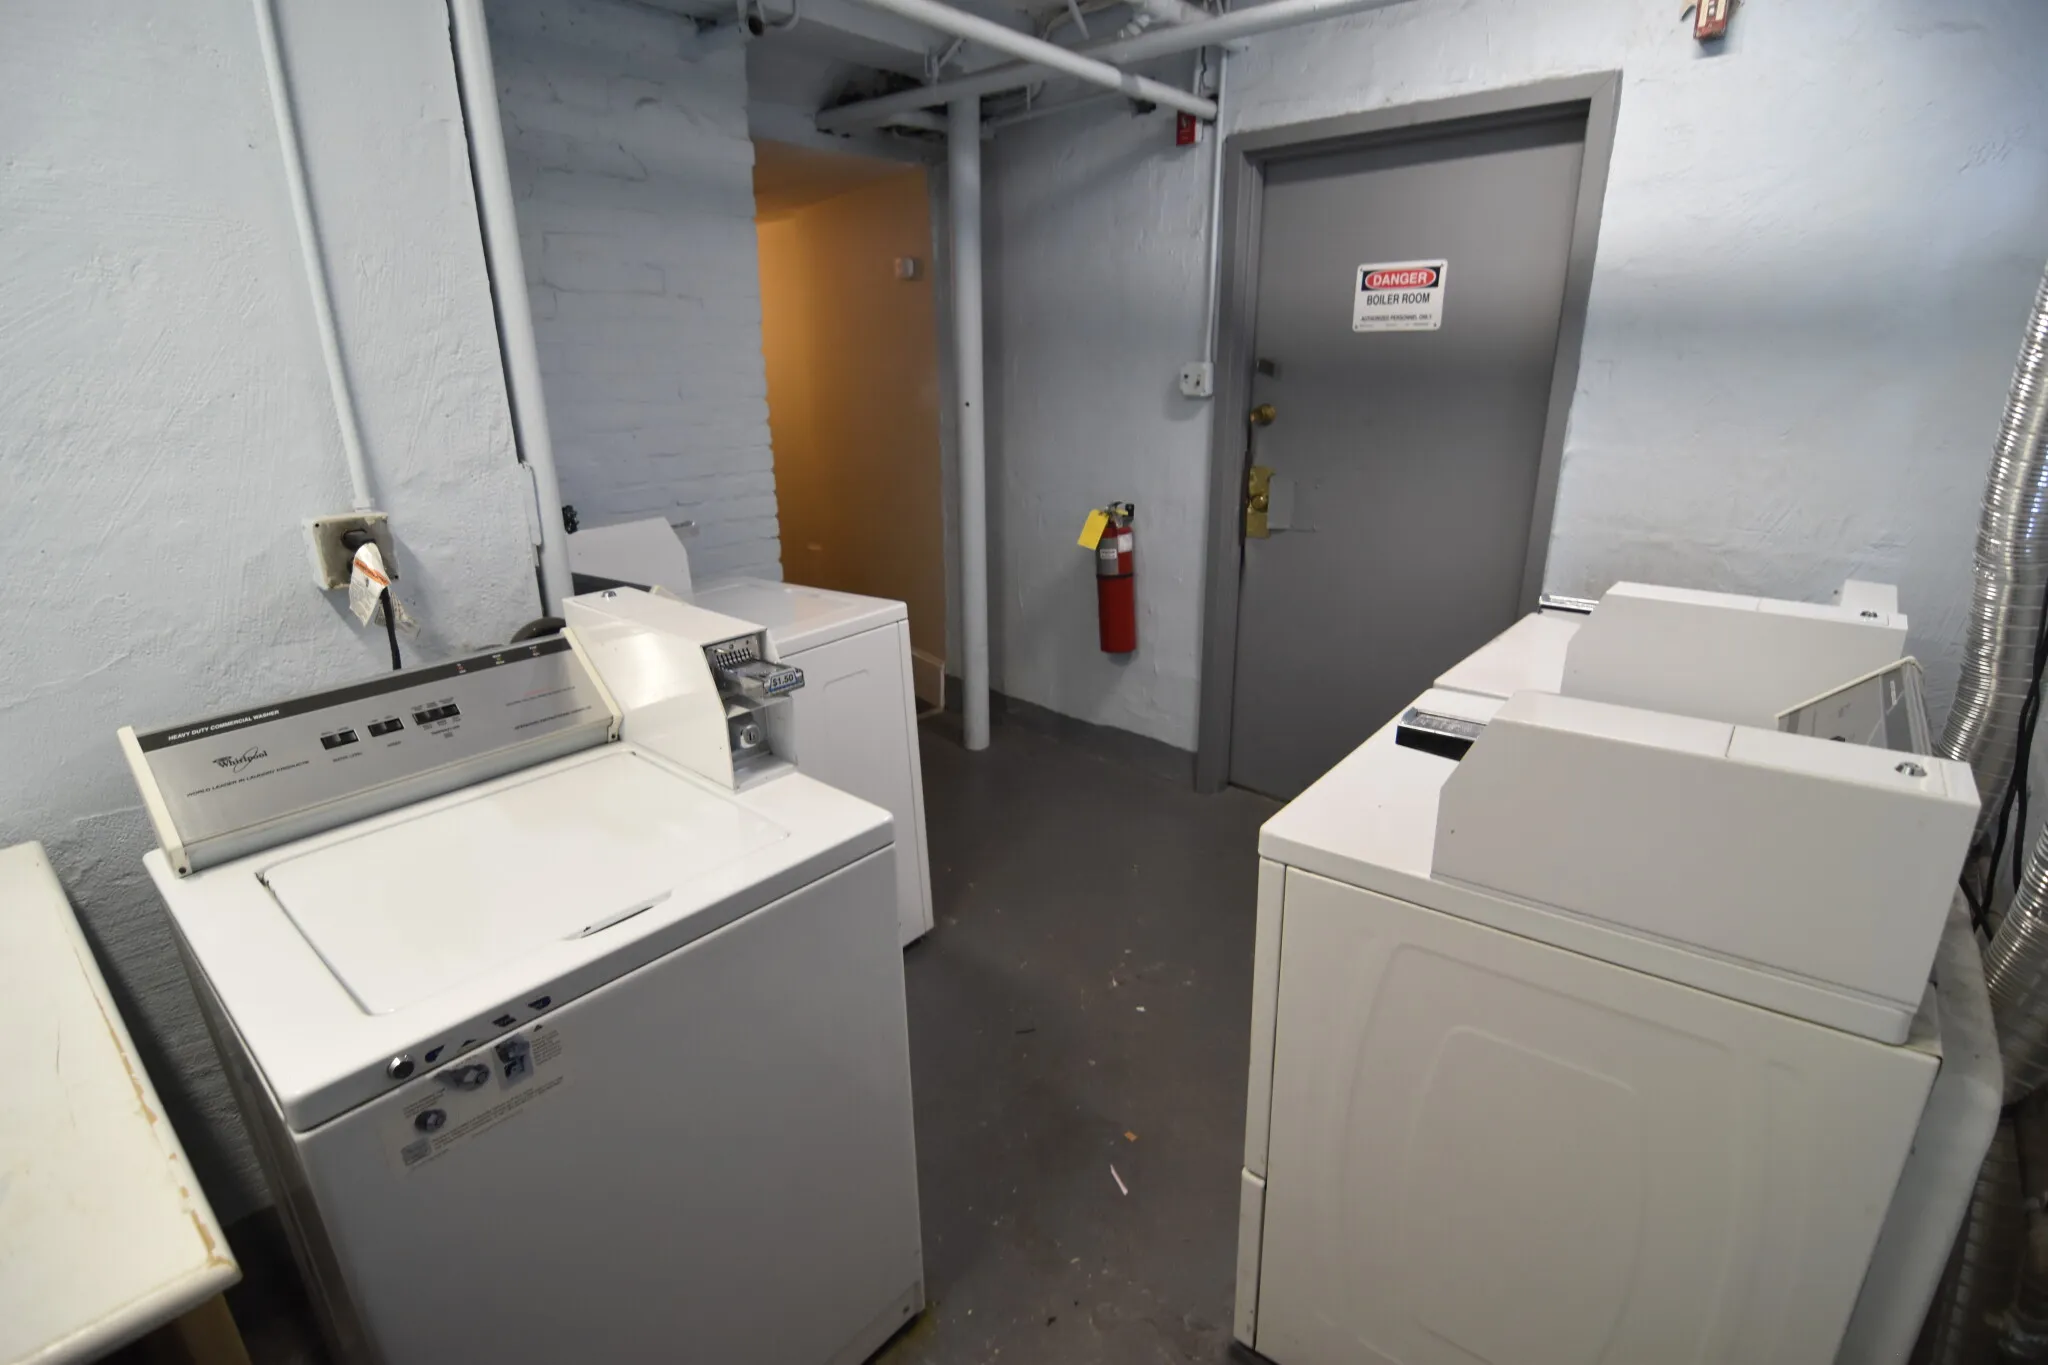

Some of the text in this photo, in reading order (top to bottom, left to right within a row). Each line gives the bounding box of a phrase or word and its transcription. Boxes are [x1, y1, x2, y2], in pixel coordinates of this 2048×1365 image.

[1372, 271, 1428, 287] DANGER
[1366, 292, 1430, 306] BOILER ROOM
[772, 673, 794, 687] $1.50
[168, 709, 280, 741] HEAVY DUTY COMMERCIAL WASHER
[215, 748, 268, 771] Whirlpool
[186, 787, 211, 797] WORLD
